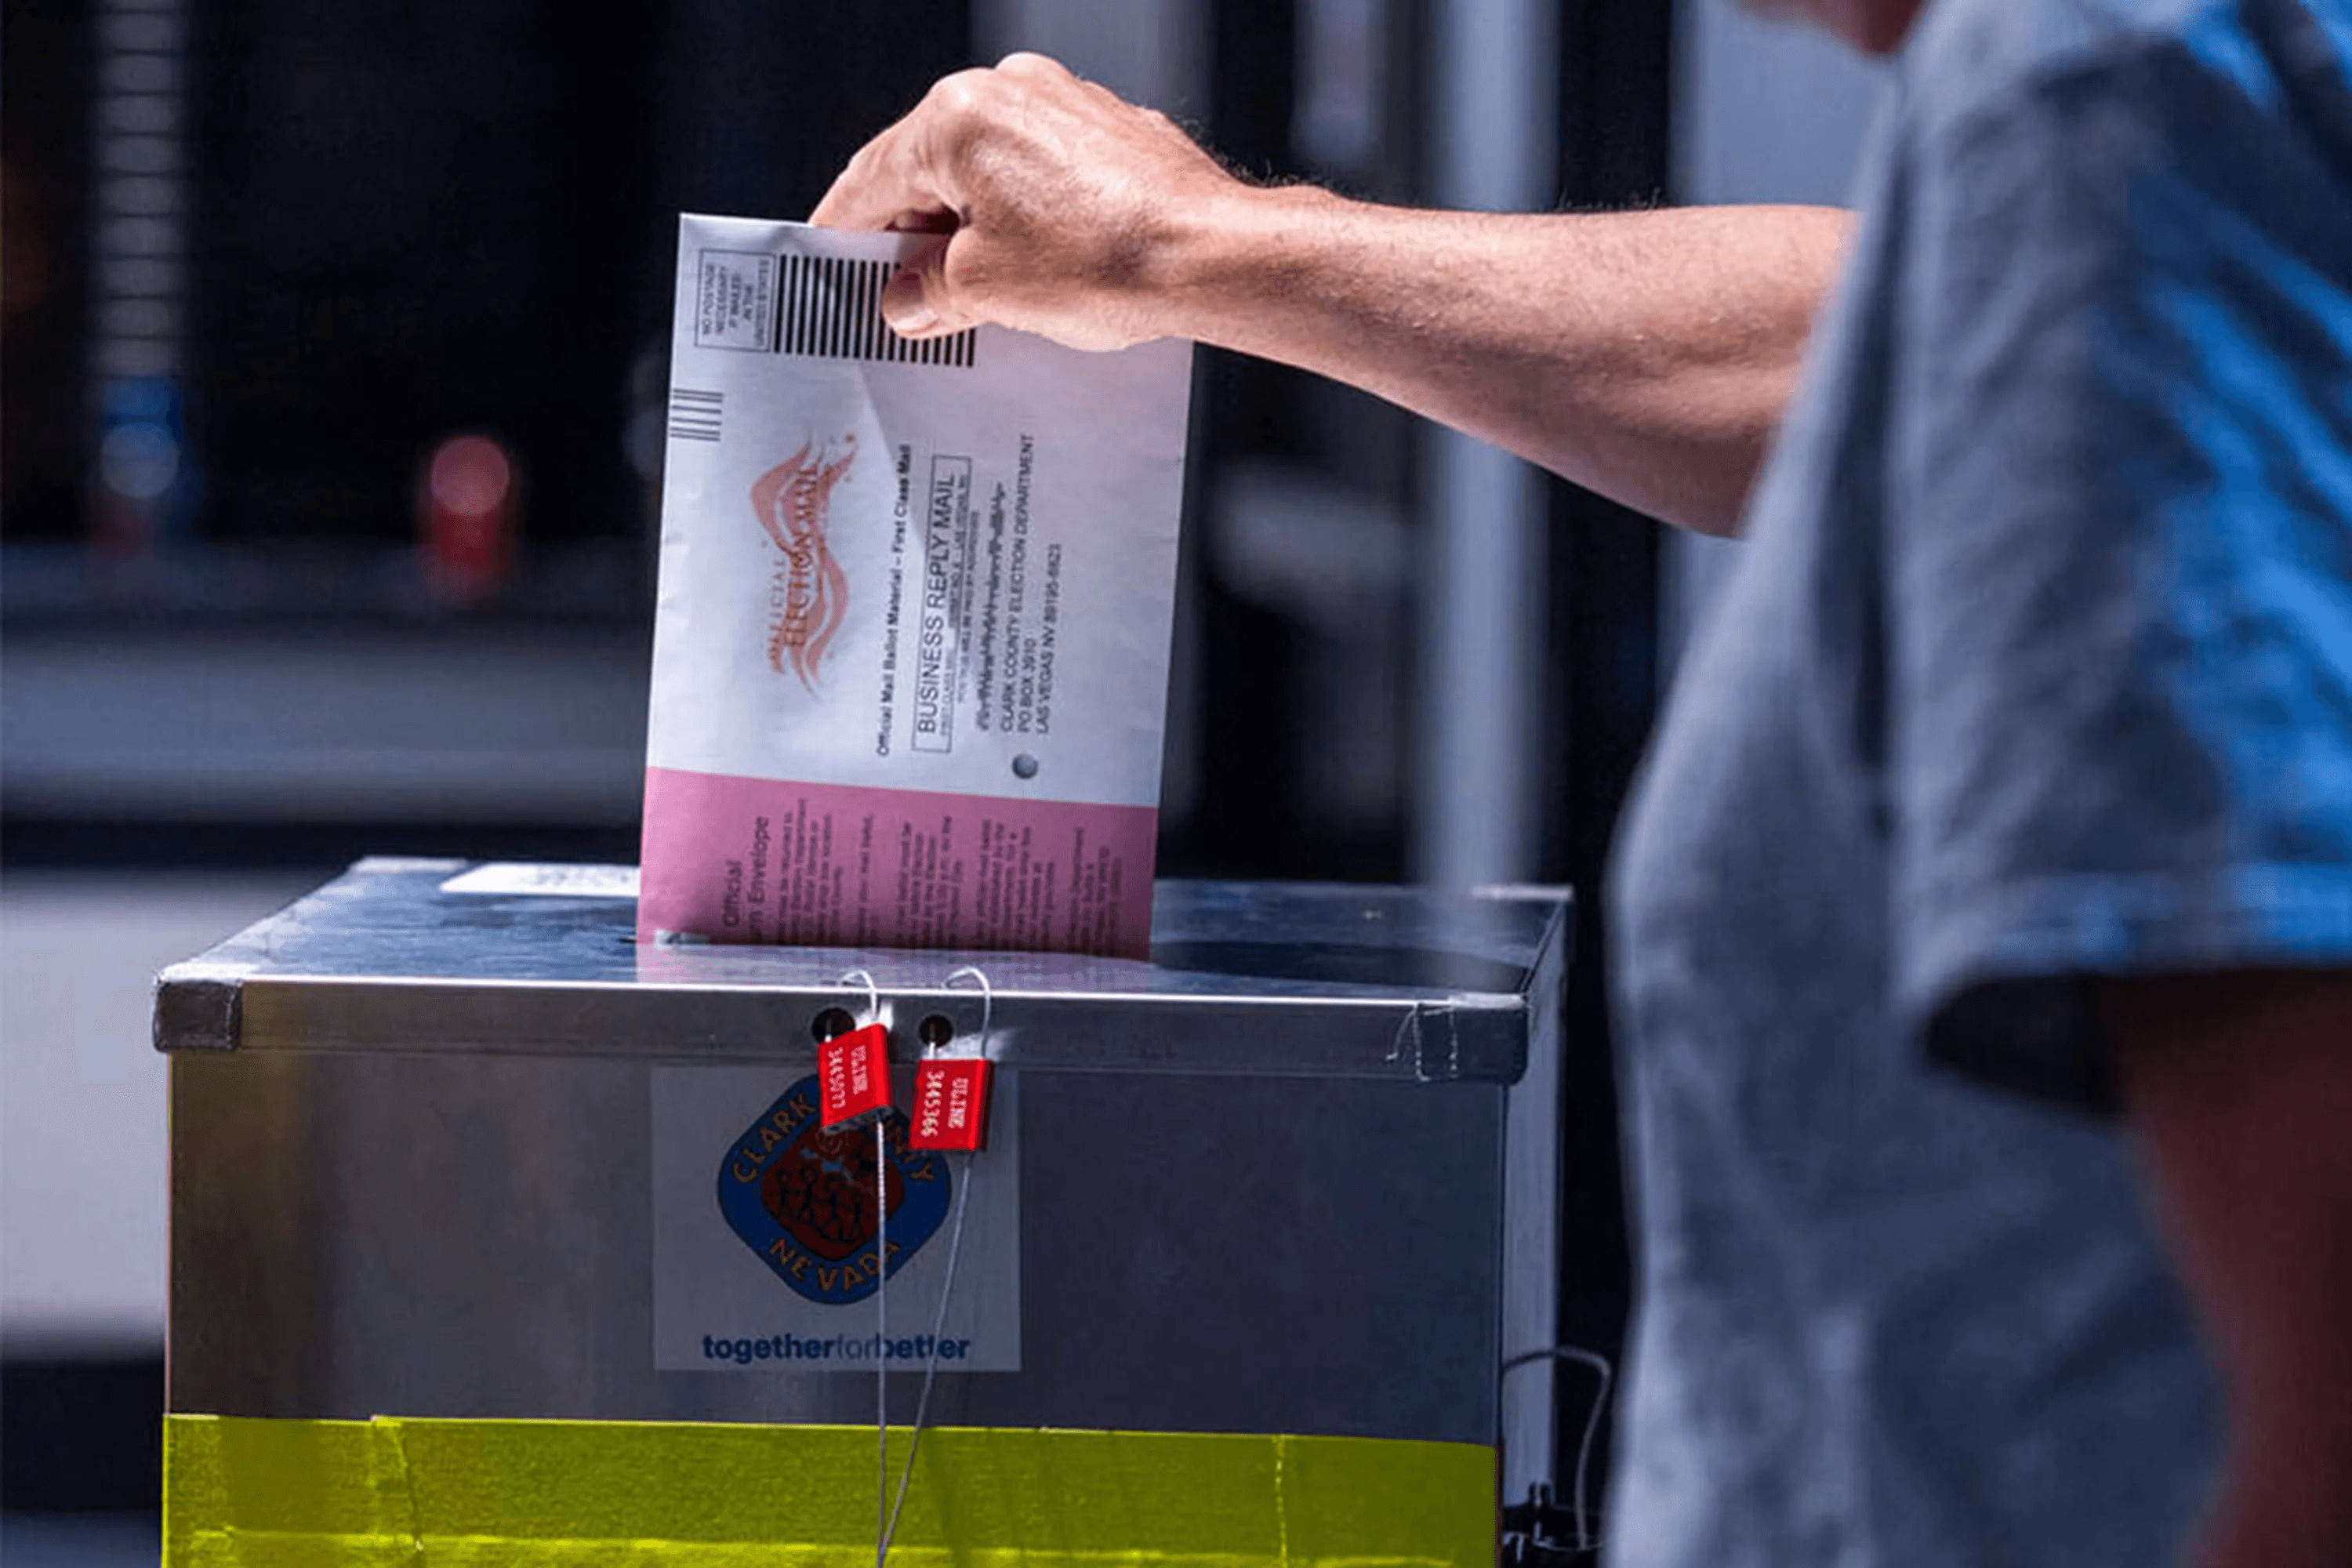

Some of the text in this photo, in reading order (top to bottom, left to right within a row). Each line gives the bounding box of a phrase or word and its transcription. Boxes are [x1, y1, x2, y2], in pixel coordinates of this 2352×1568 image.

[895, 444, 911, 474] Mail
[893, 478, 909, 518] Class
[784, 463, 818, 647] ELECTION MAIL
[889, 521, 907, 553] First
[886, 569, 902, 626] Material
[917, 474, 955, 733] BUSINESS REPLY MAIL
[999, 434, 1034, 731] CLARK COUNTY ELECTION DEPARTMENT
[882, 629, 898, 670] Ballot
[1042, 626, 1055, 648] NV
[880, 673, 895, 703] Mail
[1019, 677, 1034, 707] BOX
[1037, 651, 1054, 703] VEGAS
[876, 706, 893, 757] Official
[1018, 711, 1032, 732] PO
[1036, 706, 1050, 734] LAS
[747, 817, 771, 903] Envelope
[721, 860, 742, 927] Official
[851, 1044, 868, 1095] ULINE
[948, 1077, 969, 1129] ULINE
[731, 1091, 817, 1183] CLARK
[769, 1238, 901, 1291] NEVADA
[703, 1333, 971, 1364] togetherforbetter
